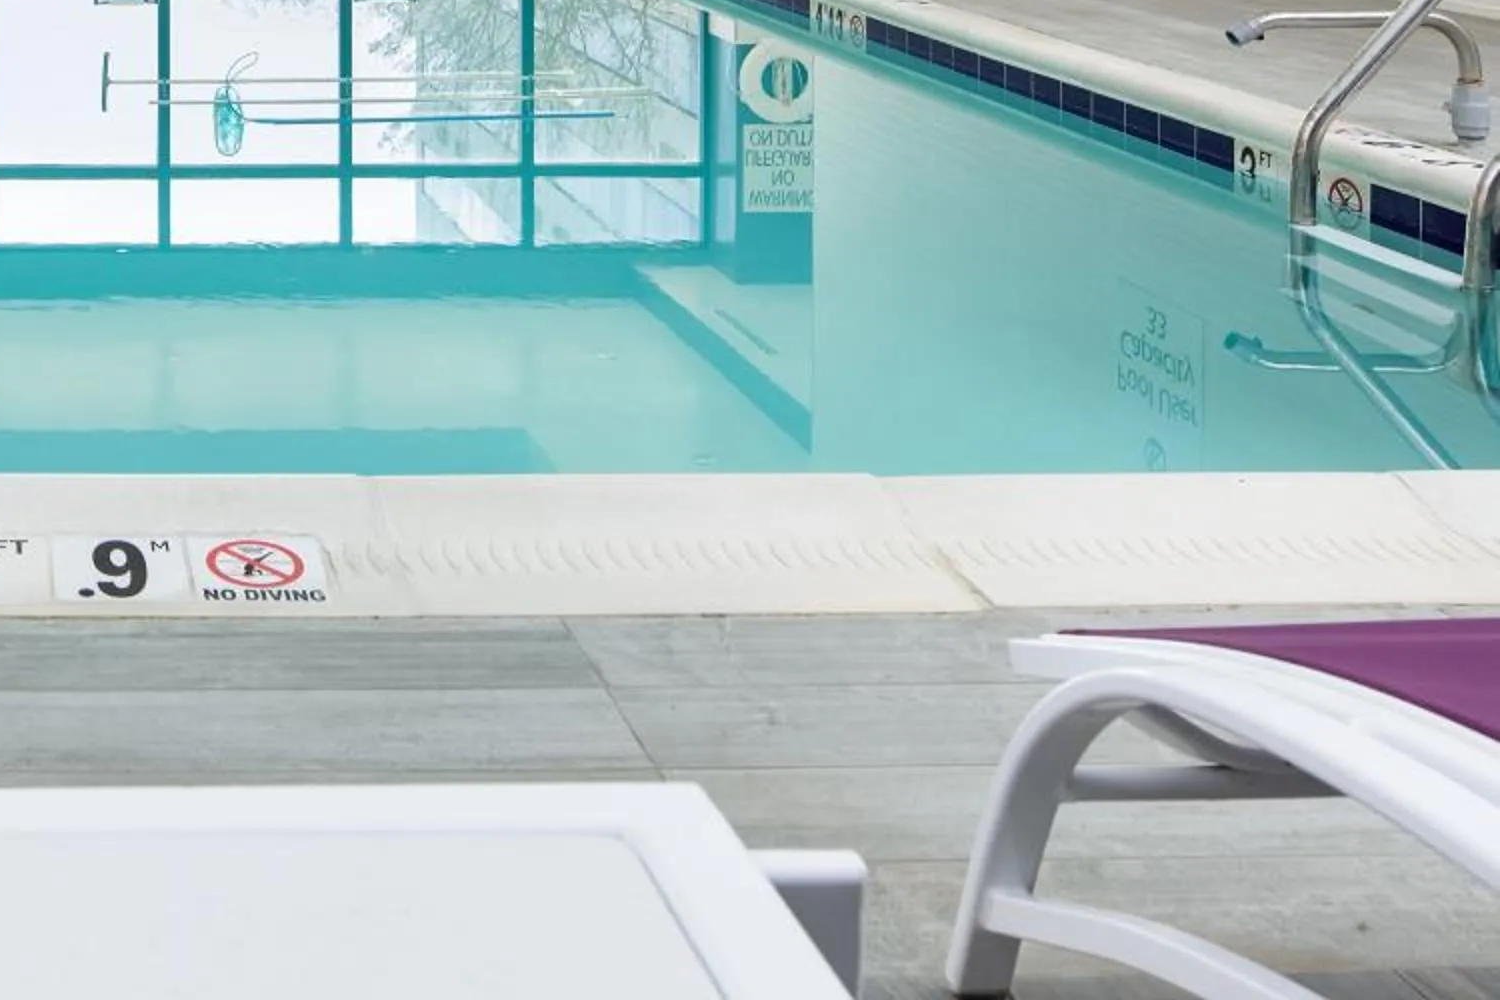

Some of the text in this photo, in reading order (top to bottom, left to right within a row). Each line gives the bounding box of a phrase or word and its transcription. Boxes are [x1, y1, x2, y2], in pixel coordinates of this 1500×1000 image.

[78, 539, 149, 599] .9
[150, 541, 170, 552] M
[202, 588, 326, 602] NO DIVING
